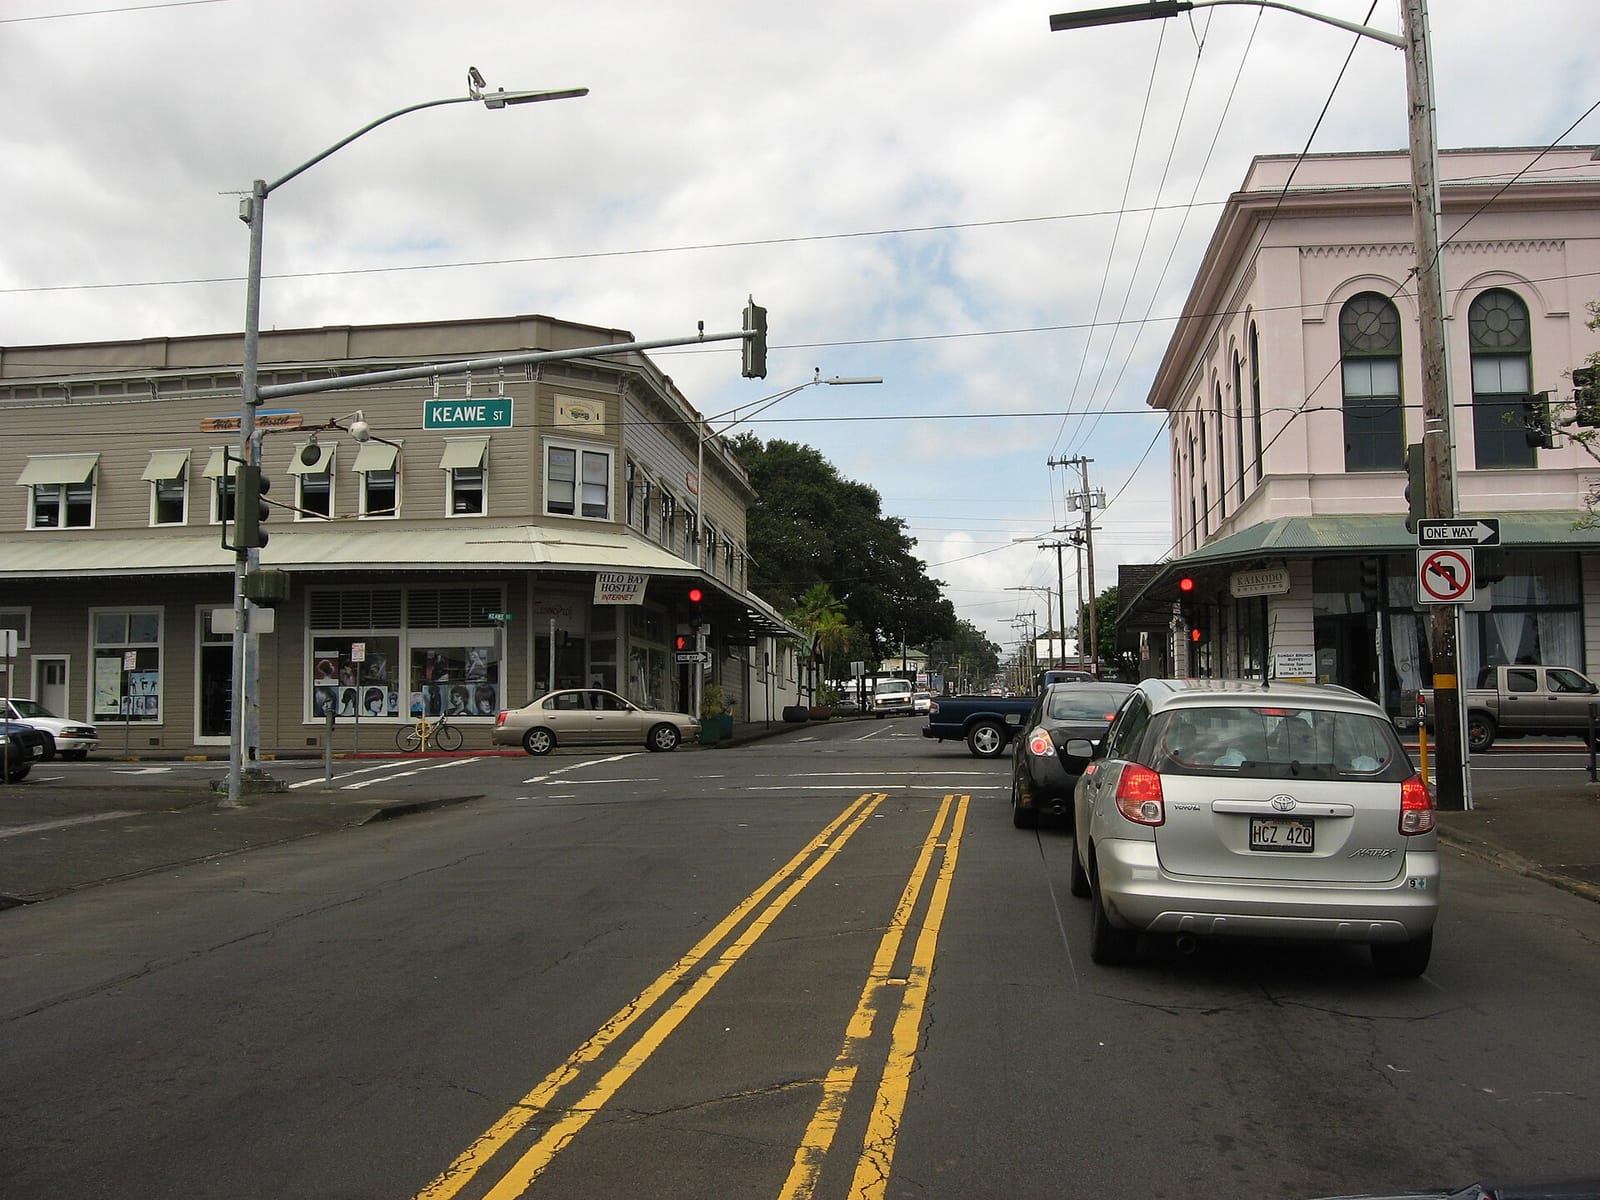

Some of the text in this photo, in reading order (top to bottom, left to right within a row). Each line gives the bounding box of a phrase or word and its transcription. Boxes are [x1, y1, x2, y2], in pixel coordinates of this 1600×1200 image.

[432, 406, 504, 422] KEAWE ST
[258, 415, 290, 427] Hostel
[1426, 527, 1474, 538] ONE WAY
[599, 573, 644, 584] HILO BAY
[1237, 573, 1283, 586] KAIKODO
[601, 583, 639, 593] HOSTEL
[600, 593, 634, 601] INTERNET
[1174, 803, 1201, 811] TOYOTA
[1253, 825, 1311, 845] HCZ 420
[1347, 848, 1397, 859] MATRIX
